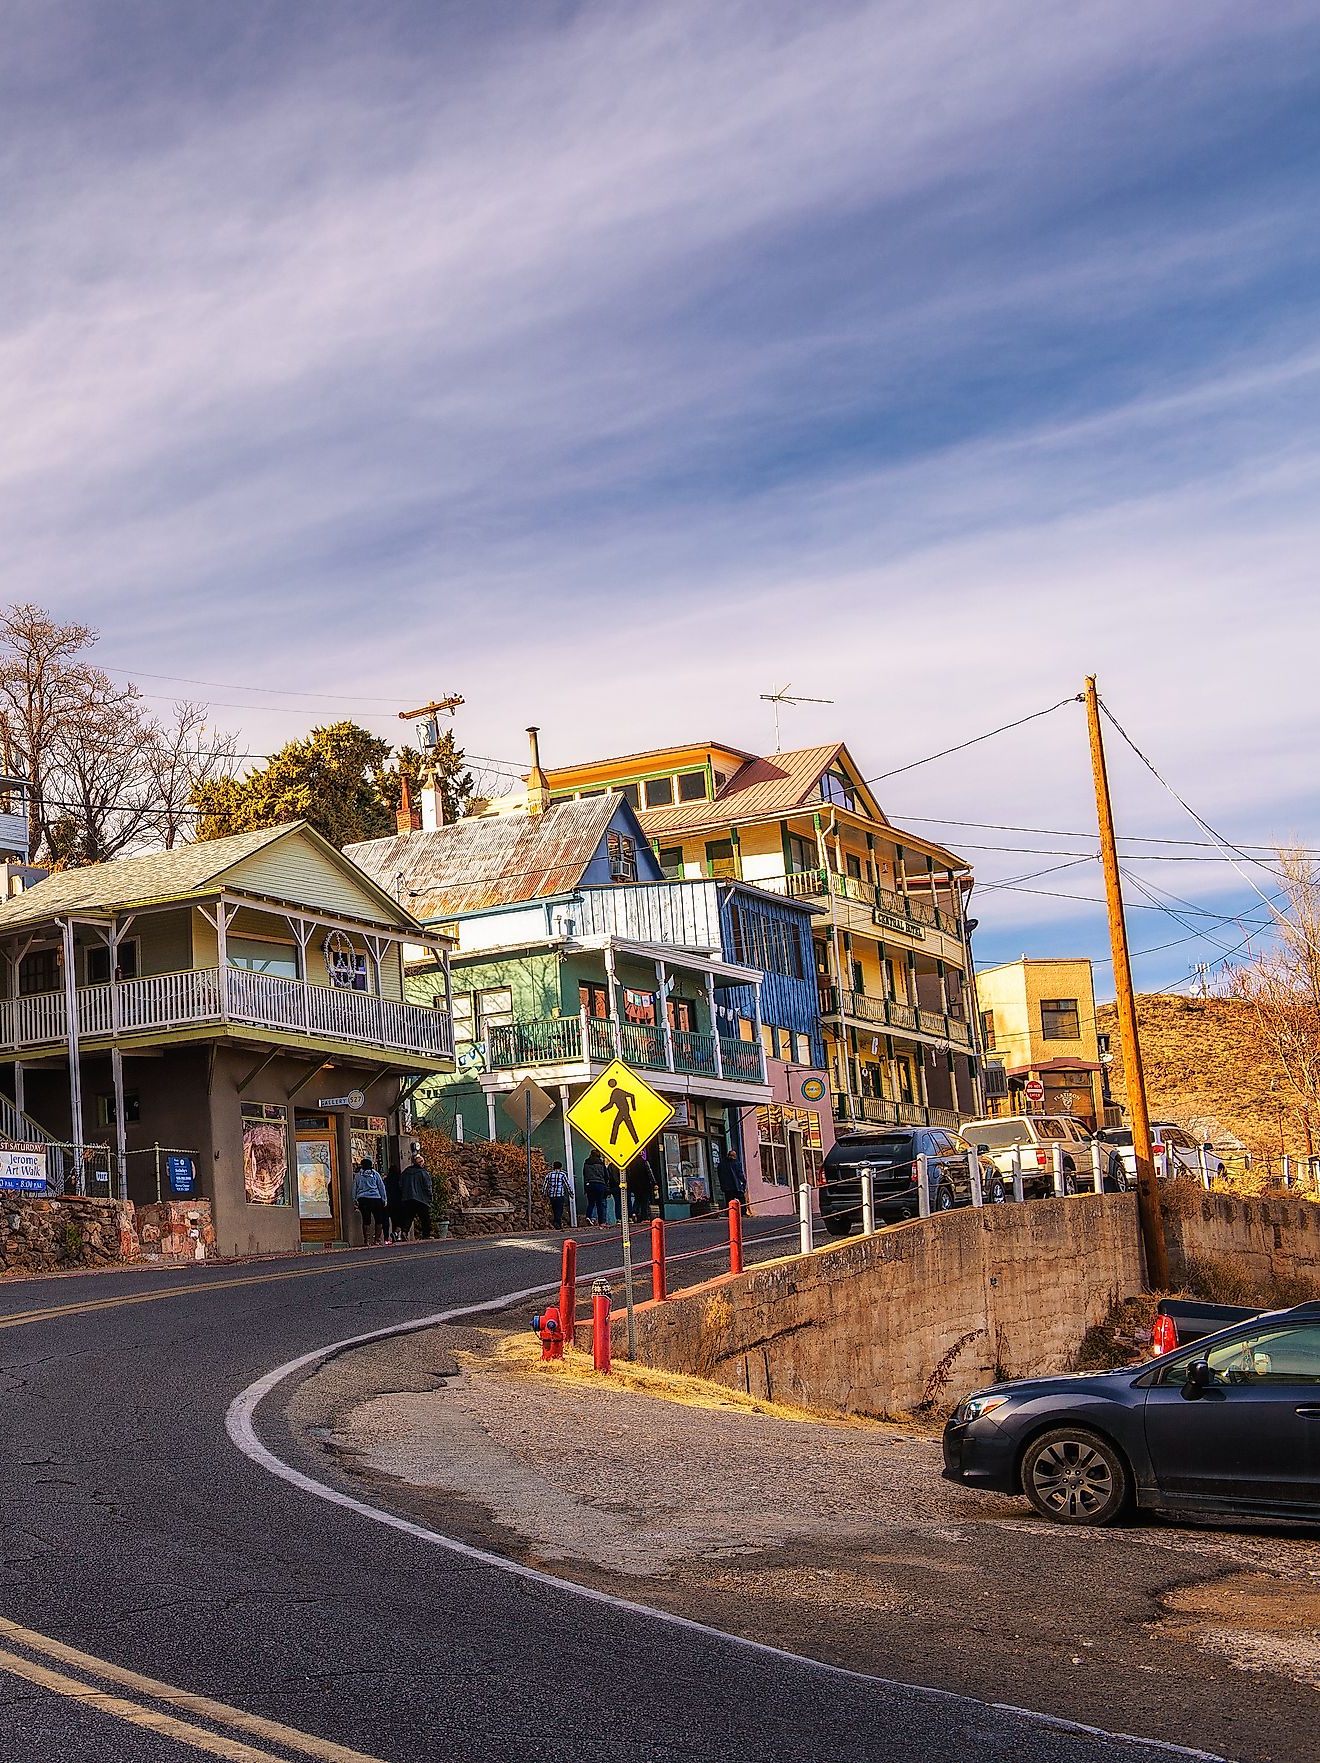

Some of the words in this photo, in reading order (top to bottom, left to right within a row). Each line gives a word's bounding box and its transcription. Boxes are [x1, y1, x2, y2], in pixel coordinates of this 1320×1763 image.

[878, 912, 904, 930] CENTRAL
[905, 922, 923, 937] HOTEL
[1053, 1092, 1081, 1101] FLATIRON
[10, 1143, 41, 1152] SATURDAY
[10, 1154, 38, 1165] Jerome
[6, 1166, 18, 1175] Art
[21, 1166, 40, 1176] Walk
